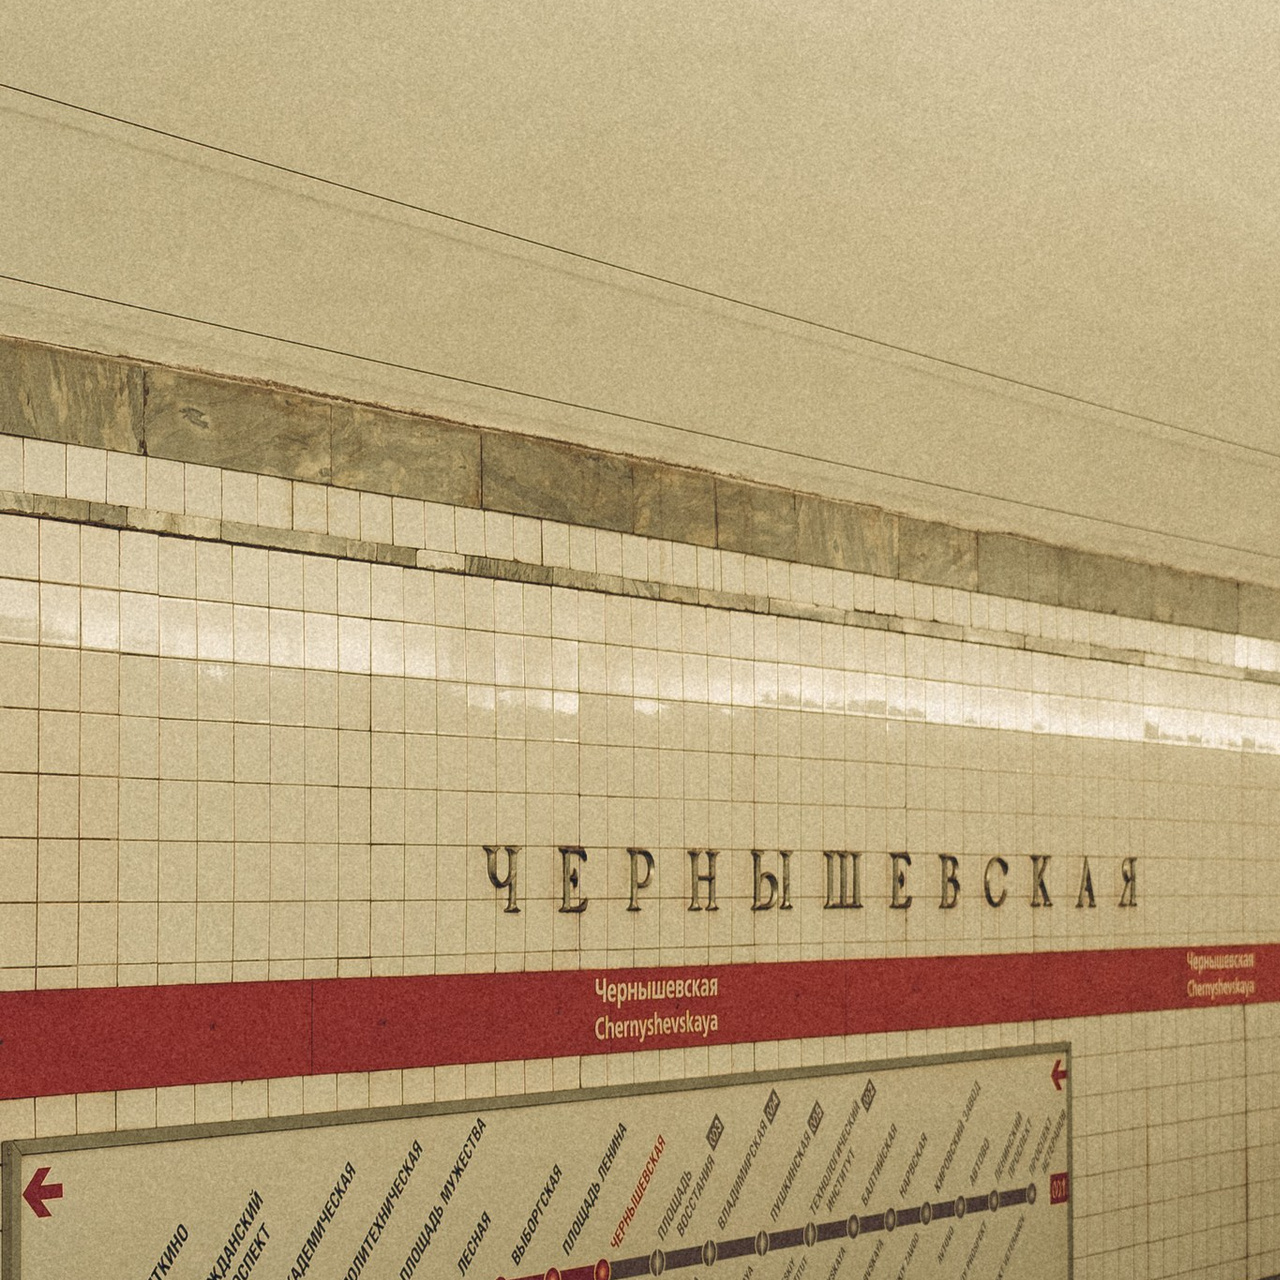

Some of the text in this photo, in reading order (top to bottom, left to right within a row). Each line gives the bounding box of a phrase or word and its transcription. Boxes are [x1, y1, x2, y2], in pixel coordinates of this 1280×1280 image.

[482, 844, 1139, 913] ЧЕРНЫШЕВСКАЯ
[594, 1009, 719, 1043] Chernyshevskaya
[595, 977, 719, 1009] Чернышевская
[440, 1117, 487, 1205] МУЖЕСТВА
[562, 1122, 627, 1256] ПЛОЩАДЬ ЛЕНИНА
[610, 1134, 666, 1249] ЧЕРНЫШЕВСКАЯ
[676, 1153, 715, 1238] ВОССТАНИЯ
[717, 1119, 768, 1231] ВЛАДИМИРСКАЯ
[770, 1130, 811, 1223] ПУШКИНСКАЯ
[809, 1099, 861, 1216] ТЕХНОЛОГИЧЕСКИЙ
[826, 1149, 855, 1213] ИНСТИТУТ
[861, 1123, 898, 1207] БАЛТИЙСКАЯ
[899, 1132, 928, 1200] НАРВСКАЯ
[456, 1210, 492, 1276] ЛЕСНАЯ
[511, 1163, 563, 1266] ВЫБОРГСКАЯ
[657, 1170, 693, 1242] ПЛОЩАДЬ
